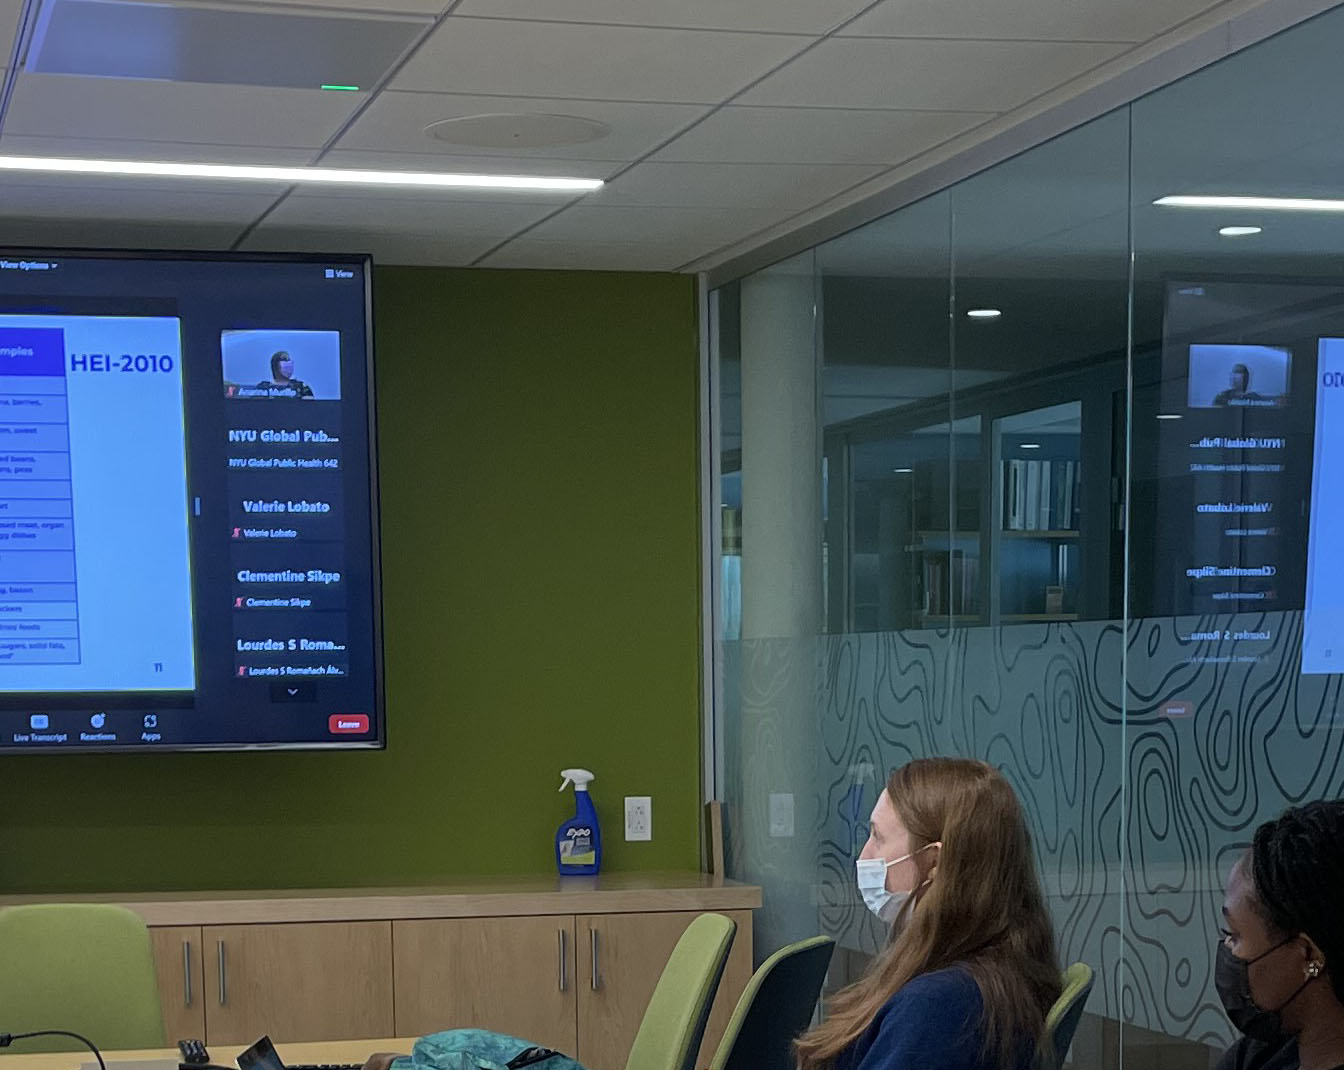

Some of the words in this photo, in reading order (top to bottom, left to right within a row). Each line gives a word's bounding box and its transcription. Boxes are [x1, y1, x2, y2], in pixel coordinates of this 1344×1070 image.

[0, 261, 18, 269] View
[20, 261, 48, 270] Options
[71, 354, 173, 372] HEI-2010
[228, 430, 256, 442] NYU
[260, 430, 300, 442] Global
[304, 430, 339, 442] Pub...
[243, 500, 286, 512] Valerie
[288, 500, 330, 512] Lobato
[244, 528, 268, 538] Valerie
[270, 528, 296, 538] Lobato
[237, 570, 305, 582] Clementine
[307, 570, 340, 584] Sikpe
[246, 598, 288, 606] Clementine
[290, 598, 311, 608] Sikpe
[237, 639, 284, 650] Lourdes
[288, 639, 296, 650] S
[300, 639, 345, 650] Roma...
[14, 734, 28, 743] Live
[30, 734, 67, 743] Transcript
[80, 732, 116, 742] Reactions
[141, 732, 160, 742] Apps
